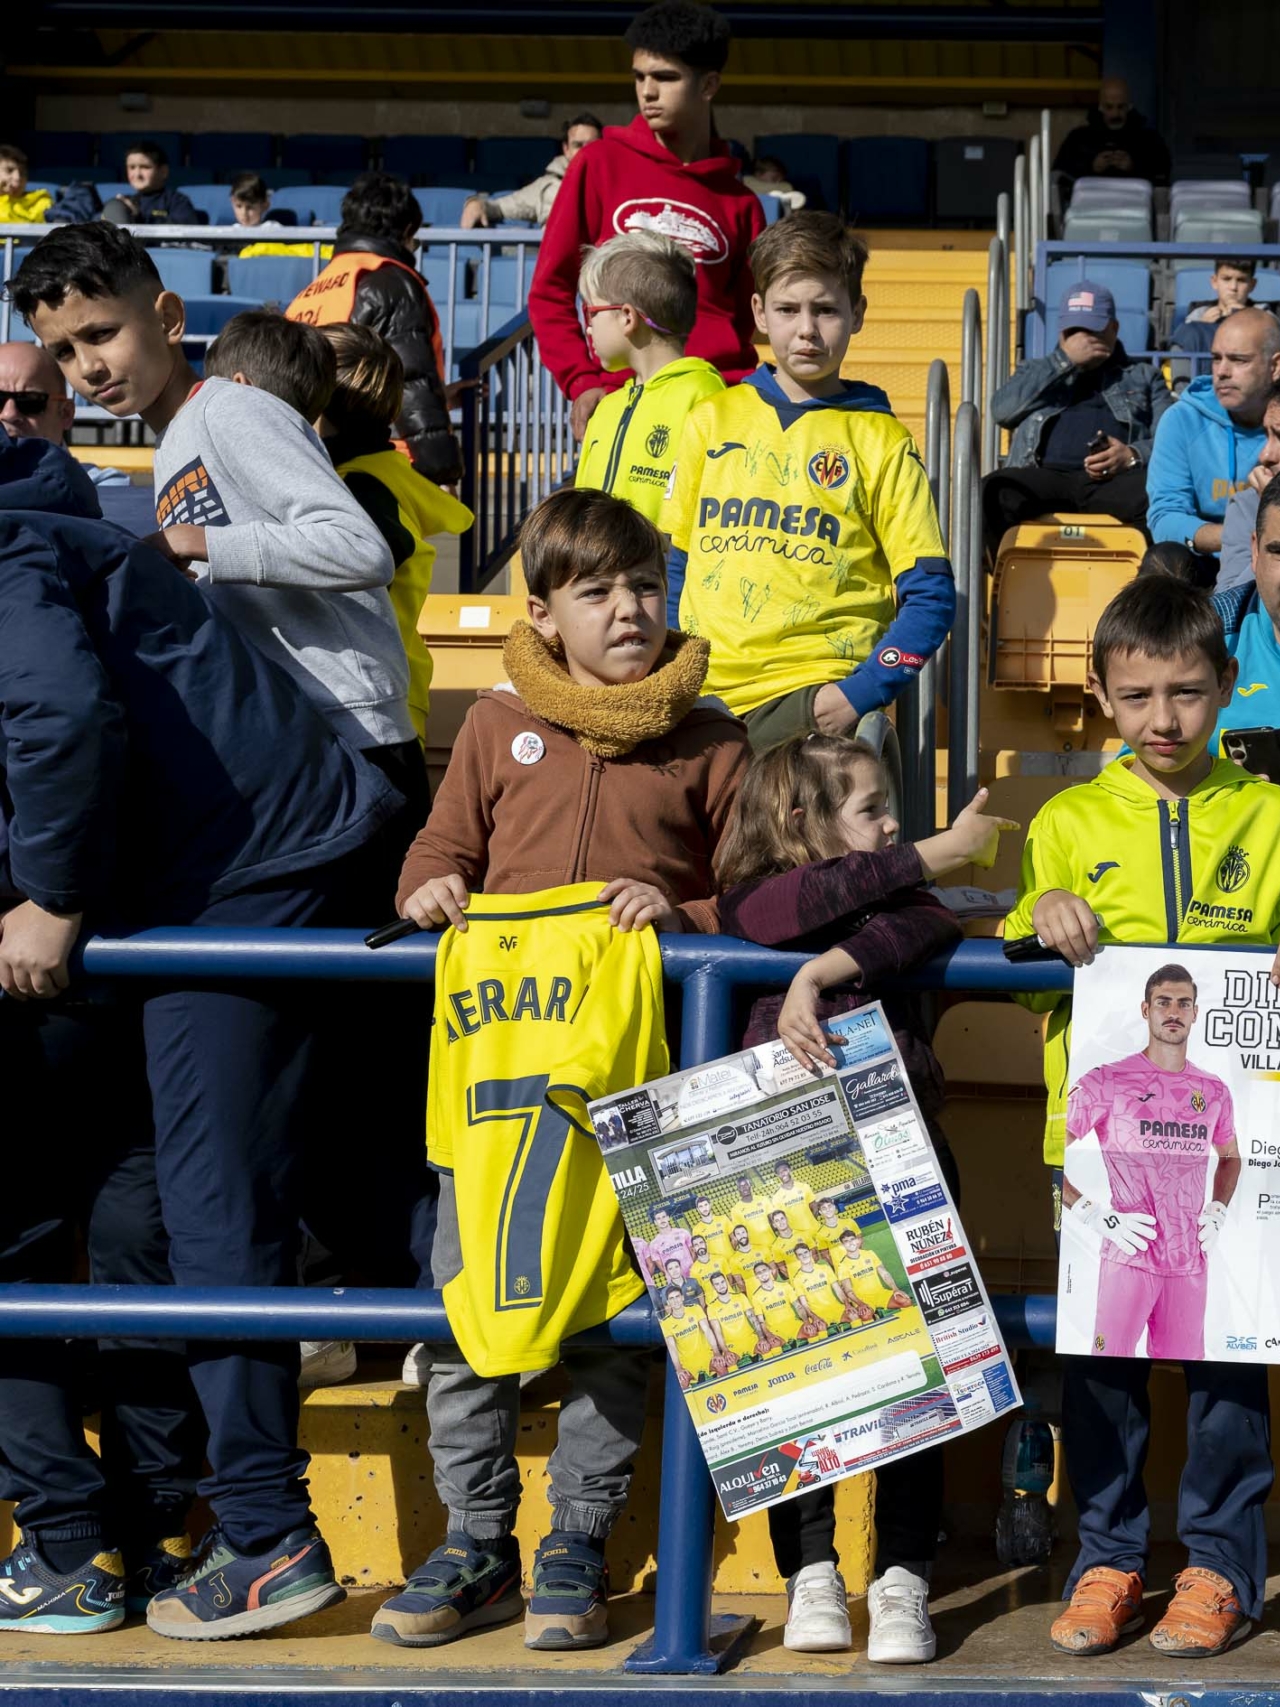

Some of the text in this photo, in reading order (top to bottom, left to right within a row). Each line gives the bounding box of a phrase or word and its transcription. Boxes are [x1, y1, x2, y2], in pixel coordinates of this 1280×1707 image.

[299, 272, 350, 298] EWARD
[630, 465, 670, 480] PAMESA
[698, 497, 841, 546] PAMESA
[1064, 526, 1080, 536] 01
[700, 530, 833, 566] cerámica
[1189, 900, 1253, 922] PAMESA
[1187, 916, 1248, 933] cerámica
[447, 976, 590, 1044] ERAR
[618, 1098, 639, 1109] TALLER
[619, 1100, 651, 1114] CHERVA
[742, 1110, 790, 1133] TANATORIO
[789, 1103, 810, 1117] SAN
[810, 1094, 831, 1110] JOSE
[812, 1110, 823, 1120] 55
[1139, 1120, 1208, 1140] PAMESA
[1142, 1138, 1205, 1152] cerámica
[1248, 1159, 1272, 1169] Diego
[466, 1073, 572, 1312] 7
[621, 1183, 650, 1199] 24/25
[891, 1177, 917, 1195] pma
[906, 1219, 945, 1241] RUBÉN
[932, 1281, 973, 1304] SupéraT
[935, 1324, 979, 1344] British Studio
[819, 1455, 841, 1474] ALTO
[541, 1547, 568, 1559] Joma
[37, 1591, 66, 1611] MAXIMA
